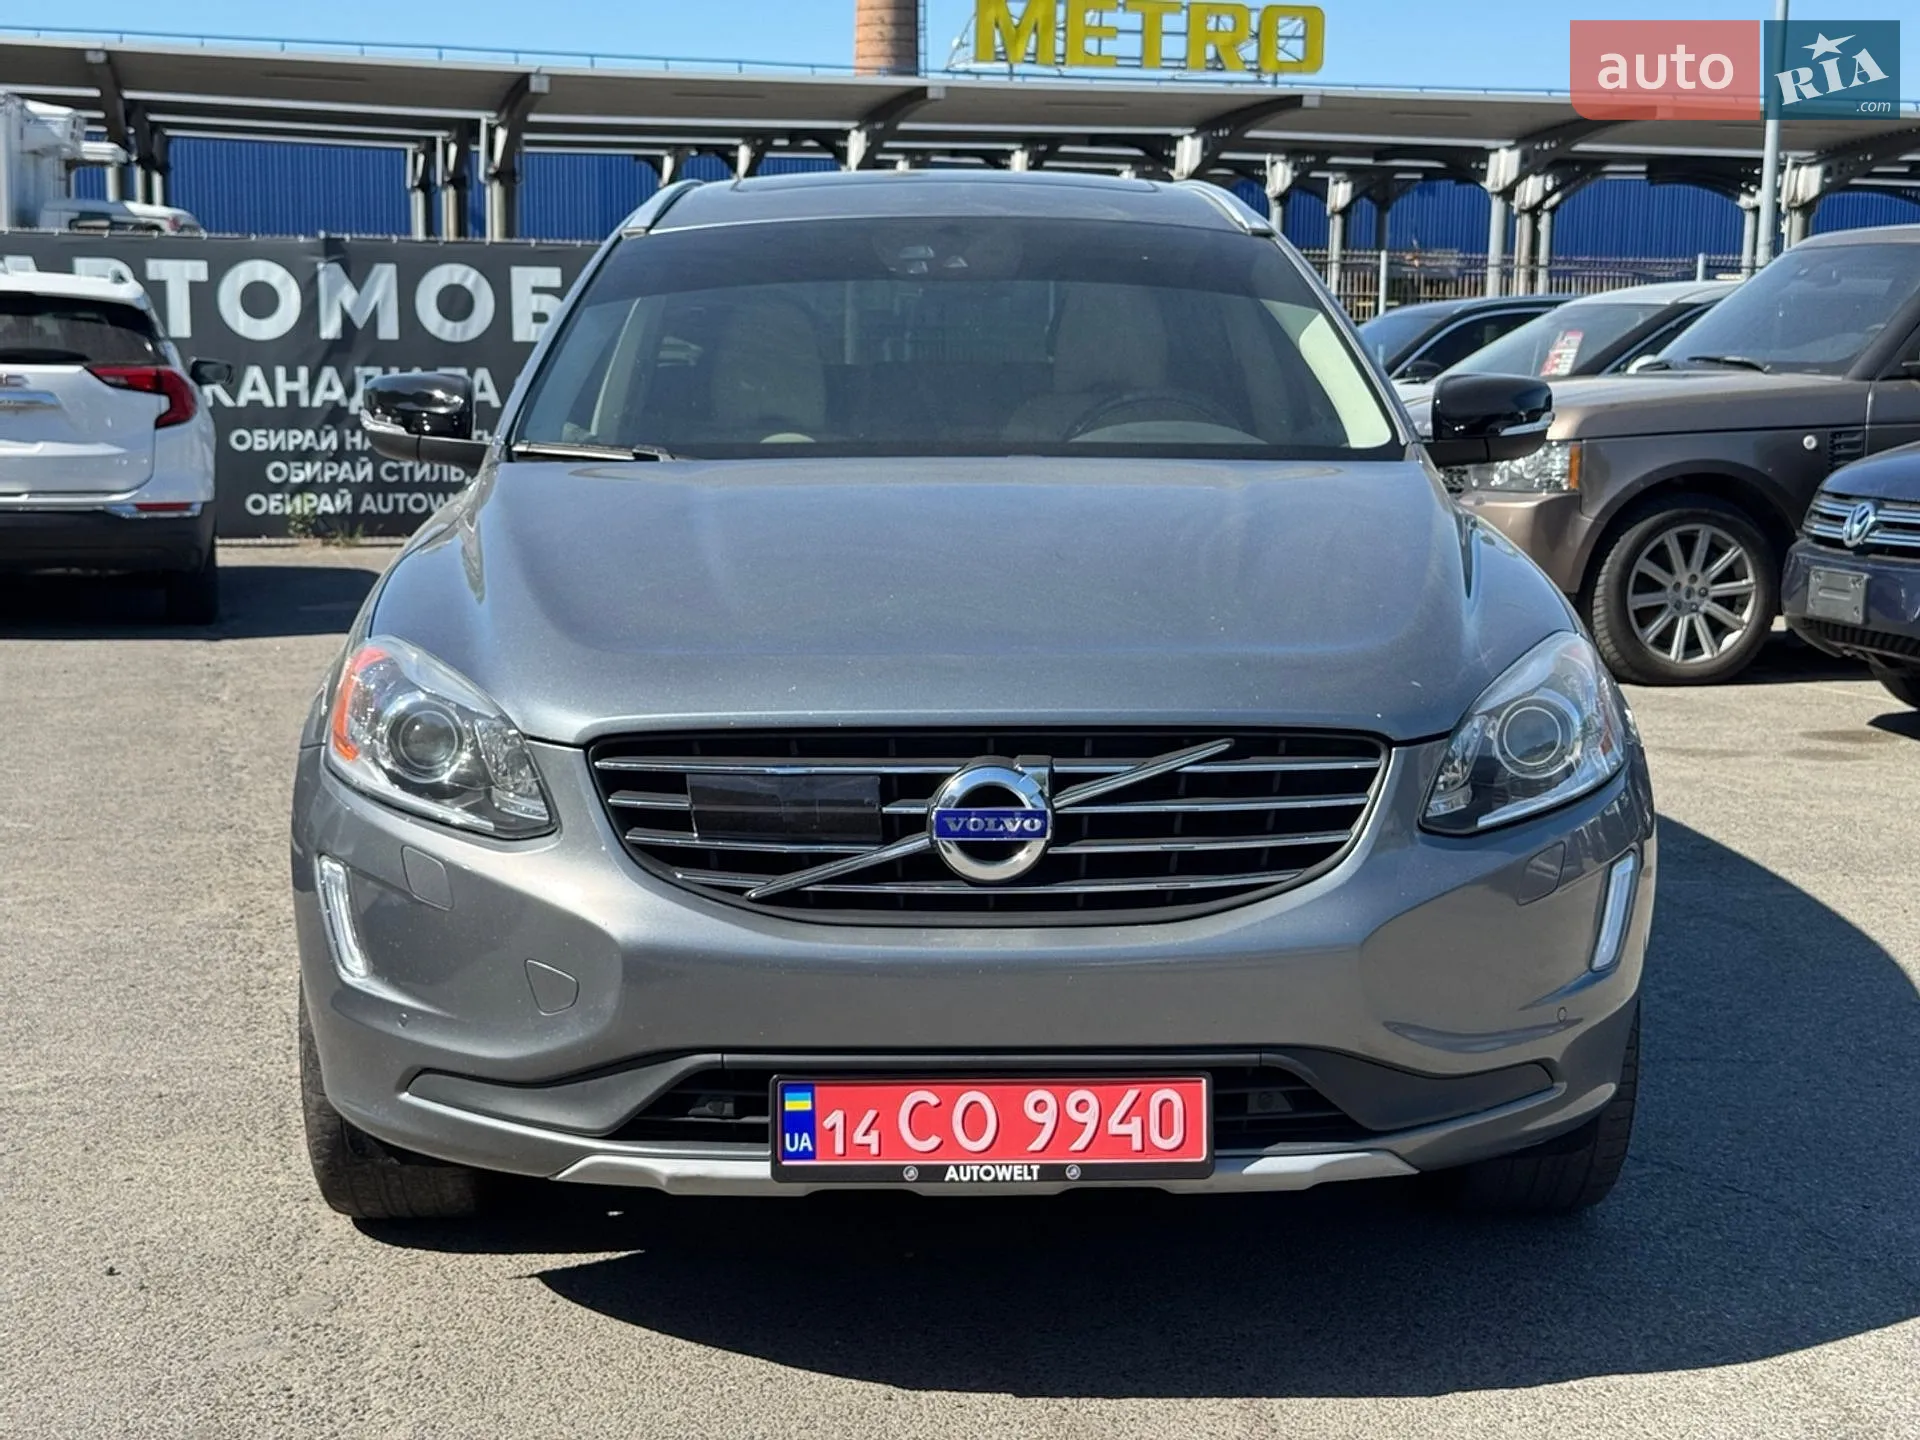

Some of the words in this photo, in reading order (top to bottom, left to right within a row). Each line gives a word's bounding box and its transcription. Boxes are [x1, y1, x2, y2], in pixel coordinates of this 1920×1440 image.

[975, 0, 1325, 74] METRO
[229, 425, 338, 451] ОБИРАЙ
[266, 457, 373, 483] ОБИРАЙ
[245, 489, 352, 516] ОБИРАЙ
[943, 817, 1042, 832] VOLVO
[822, 1109, 880, 1155] 14
[898, 1090, 999, 1153] CO
[1023, 1088, 1187, 1152] 9940
[785, 1133, 813, 1152] UA
[944, 1165, 1041, 1182] AUTOWELT
